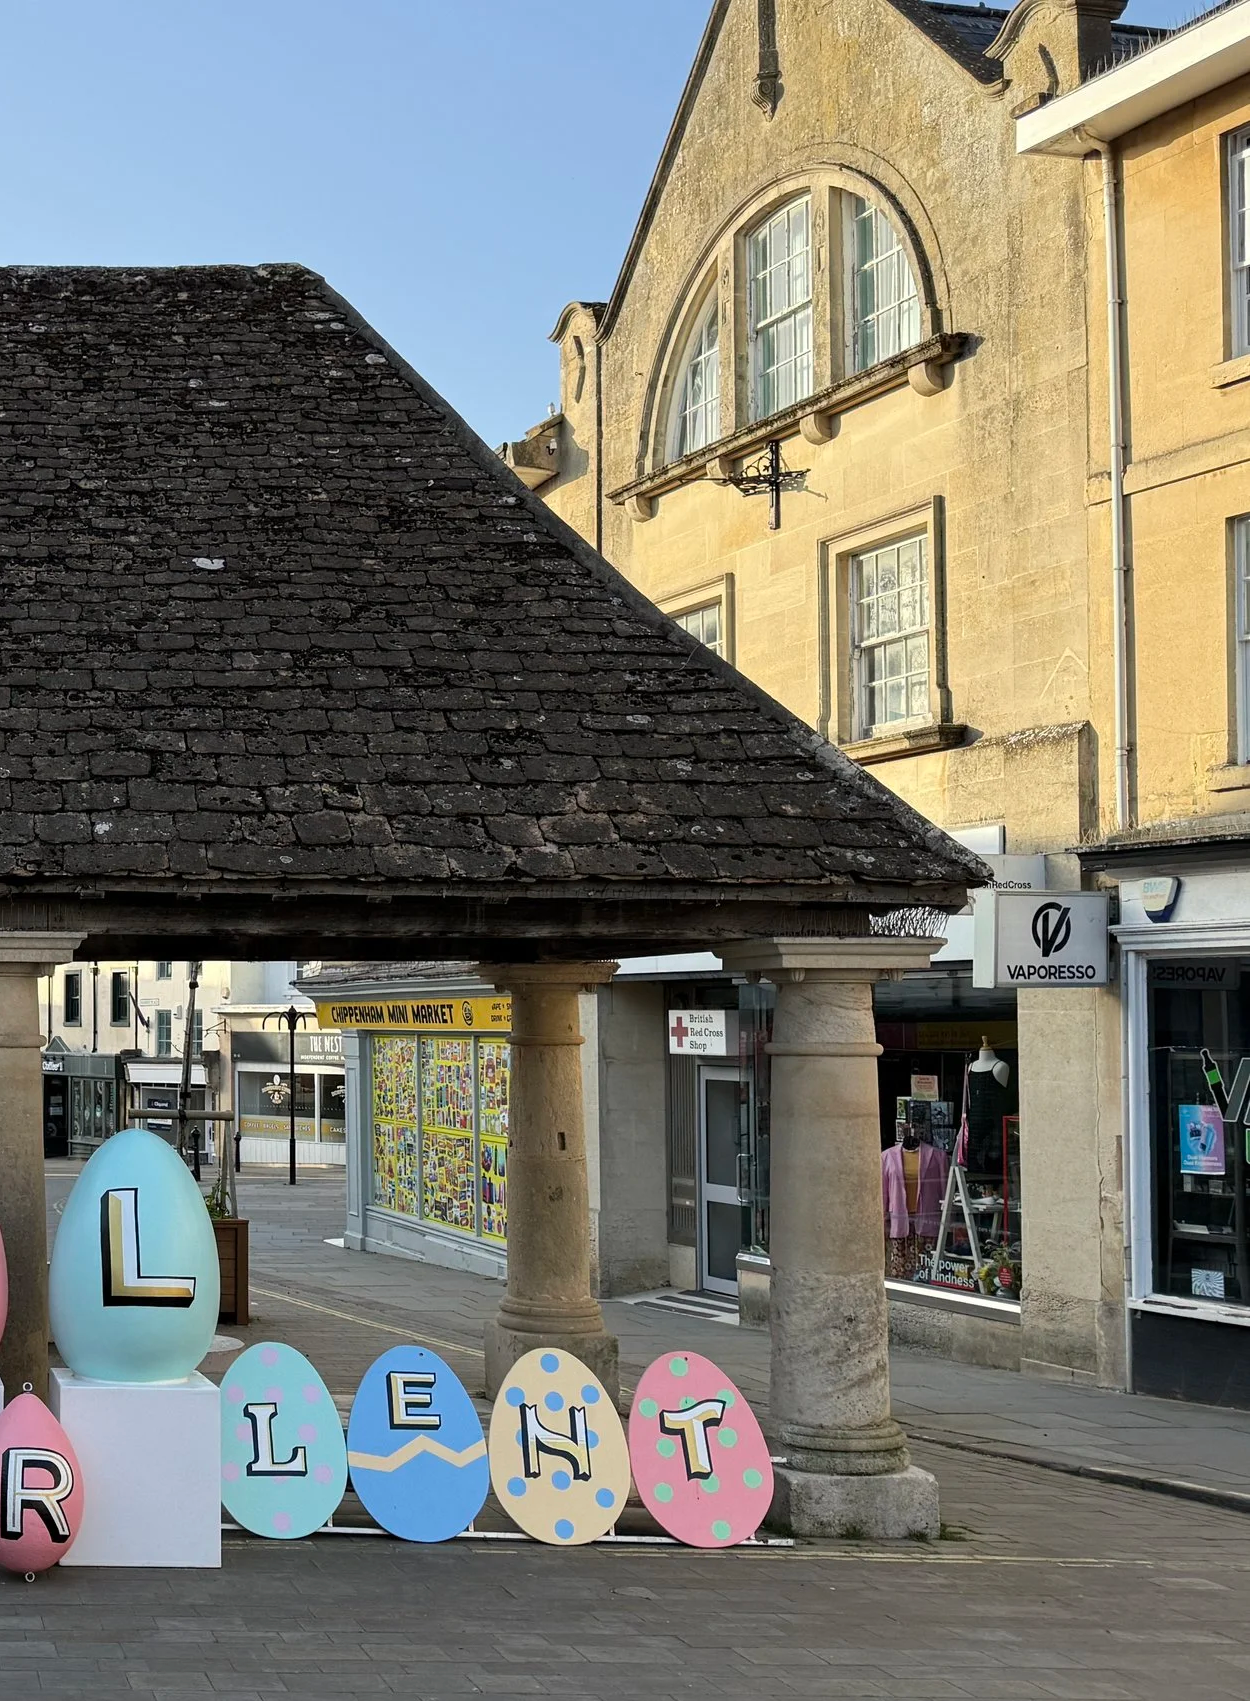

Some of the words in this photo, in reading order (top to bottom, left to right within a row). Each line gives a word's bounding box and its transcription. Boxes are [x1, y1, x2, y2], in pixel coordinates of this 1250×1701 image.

[1007, 965, 1096, 980] VAPORESSO
[331, 1005, 385, 1024] CHIPPENHAM
[388, 1004, 409, 1024] MINI
[411, 1004, 454, 1024] MARKET
[689, 1014, 713, 1023] British
[690, 1028, 703, 1037] Red
[704, 1028, 724, 1037] Cross
[310, 1036, 322, 1052] THE
[324, 1036, 342, 1053] NEST
[689, 1040, 707, 1052] Shop
[919, 1254, 935, 1268] The
[939, 1260, 970, 1273] power
[919, 1269, 929, 1280] of
